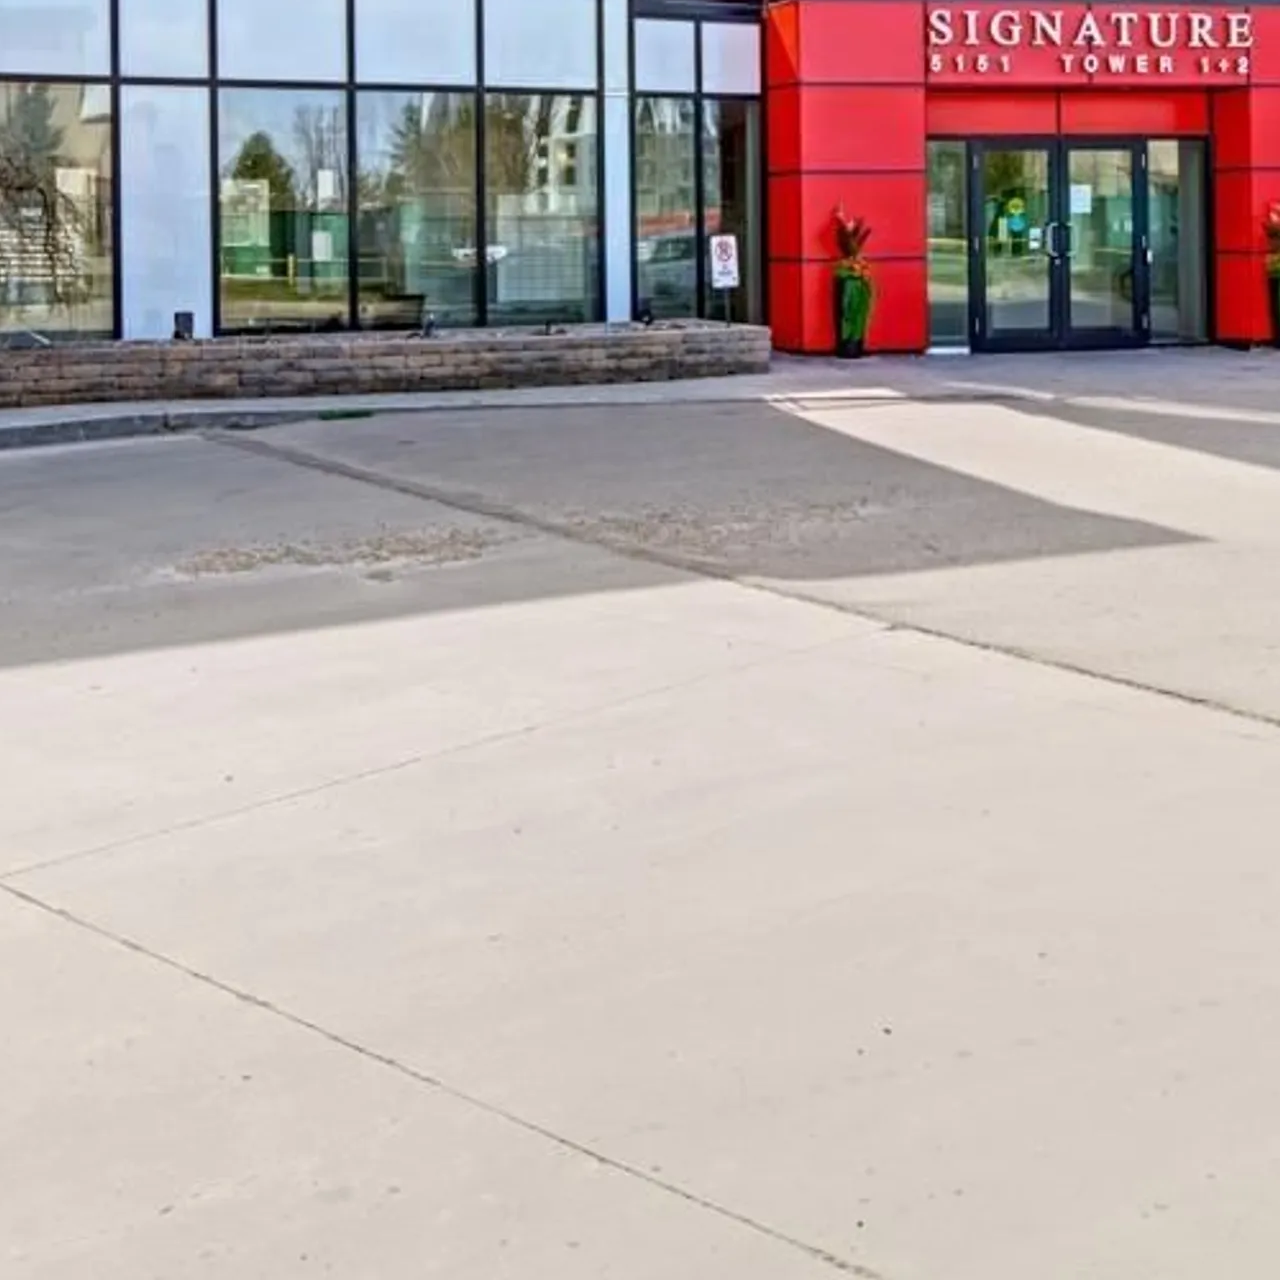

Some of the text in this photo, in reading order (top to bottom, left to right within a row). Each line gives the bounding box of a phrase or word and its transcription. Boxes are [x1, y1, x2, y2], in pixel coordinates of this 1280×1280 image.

[929, 9, 1253, 48] SIGNATURE
[930, 53, 1249, 74] 5151 TOWER 1+2
